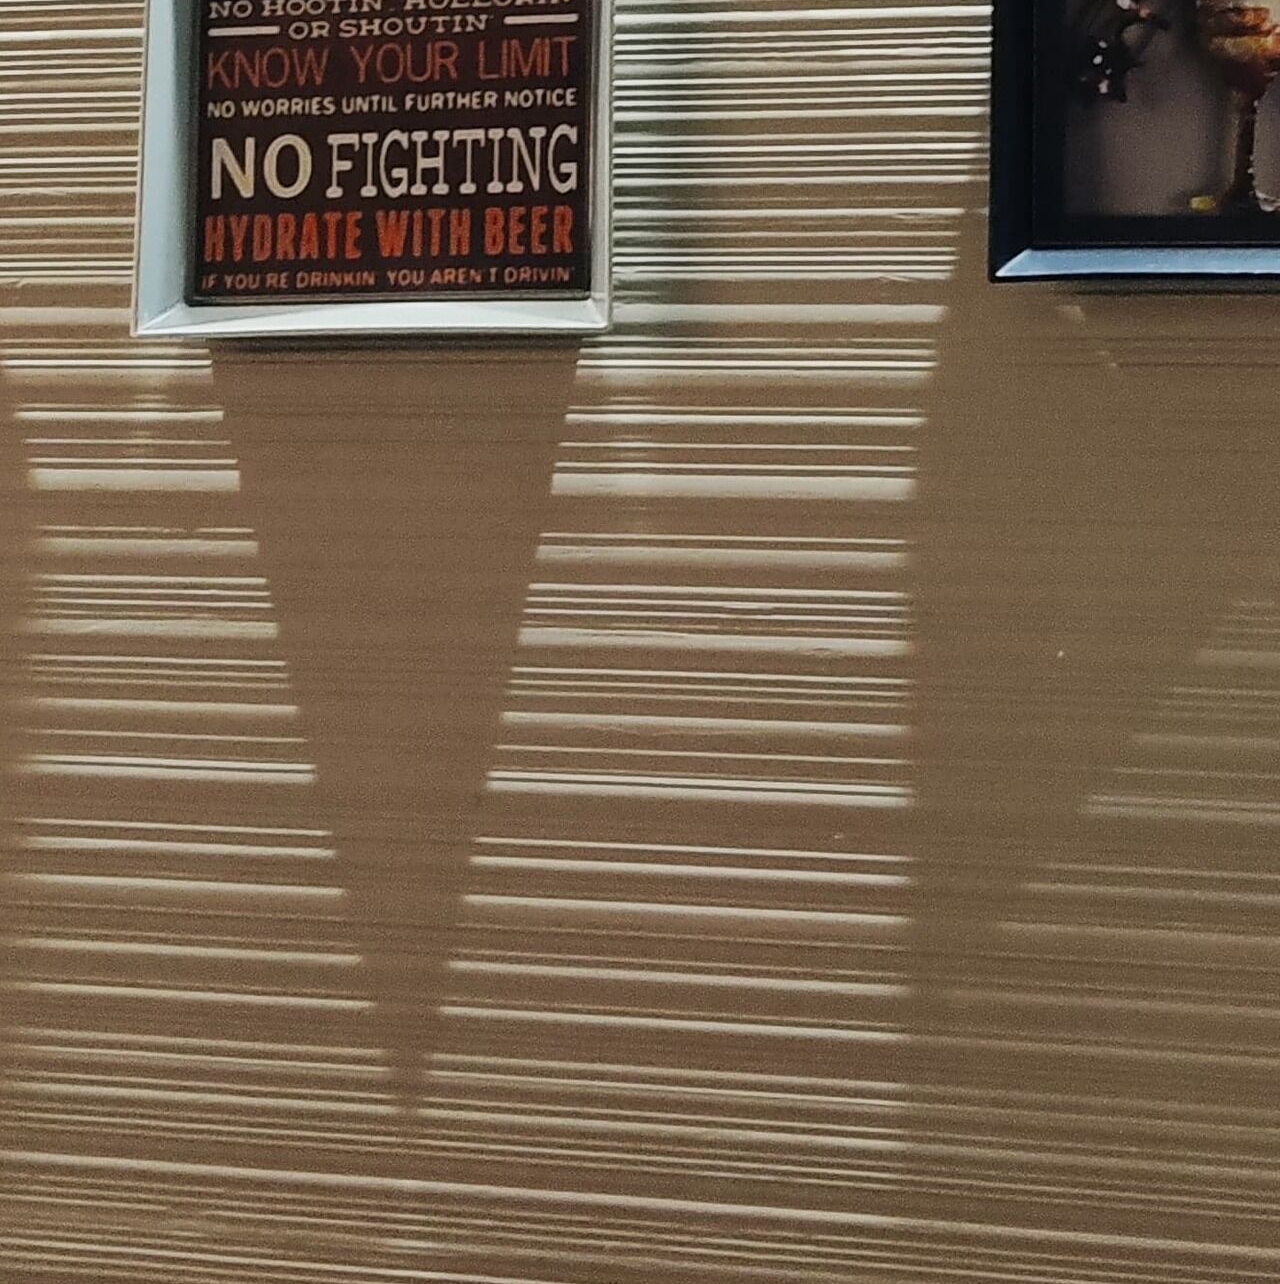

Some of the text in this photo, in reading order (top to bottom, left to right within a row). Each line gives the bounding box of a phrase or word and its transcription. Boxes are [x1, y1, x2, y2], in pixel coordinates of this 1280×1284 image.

[208, 0, 253, 19] NO
[288, 21, 330, 40] OR
[207, 36, 577, 89] KNOW YOUR LIMIT
[207, 87, 577, 118] NO WORRIES UNTIL FURTHER NOTICE
[211, 123, 578, 199] NO FIGHTING
[204, 204, 574, 263] HYDRATE WITH BEER
[202, 275, 216, 291] IF
[224, 272, 289, 290] YOURE
[387, 270, 424, 288] YOU
[430, 267, 498, 285] ARENT
